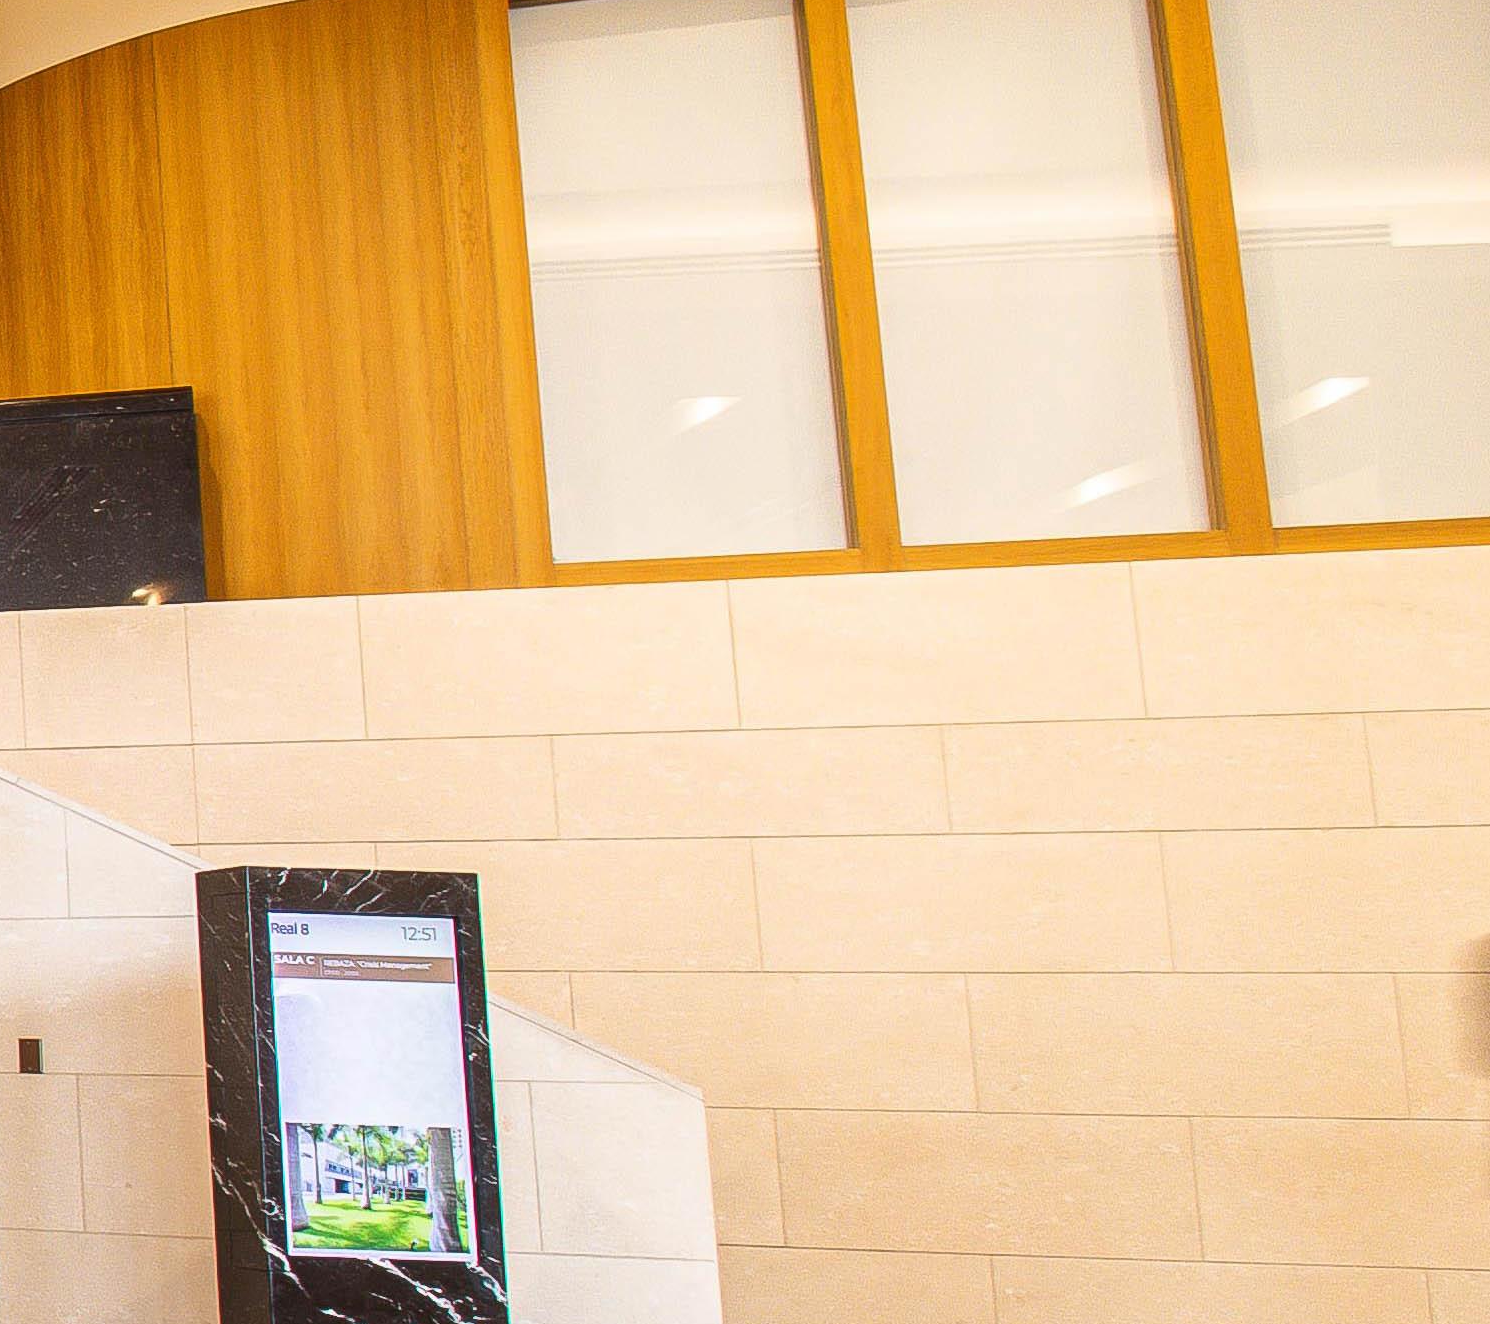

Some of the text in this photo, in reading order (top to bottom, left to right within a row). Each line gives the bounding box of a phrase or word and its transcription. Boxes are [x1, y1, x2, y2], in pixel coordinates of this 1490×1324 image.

[271, 921, 310, 936] Real 8
[400, 926, 437, 942] 12:51
[274, 954, 316, 965] SALA C
